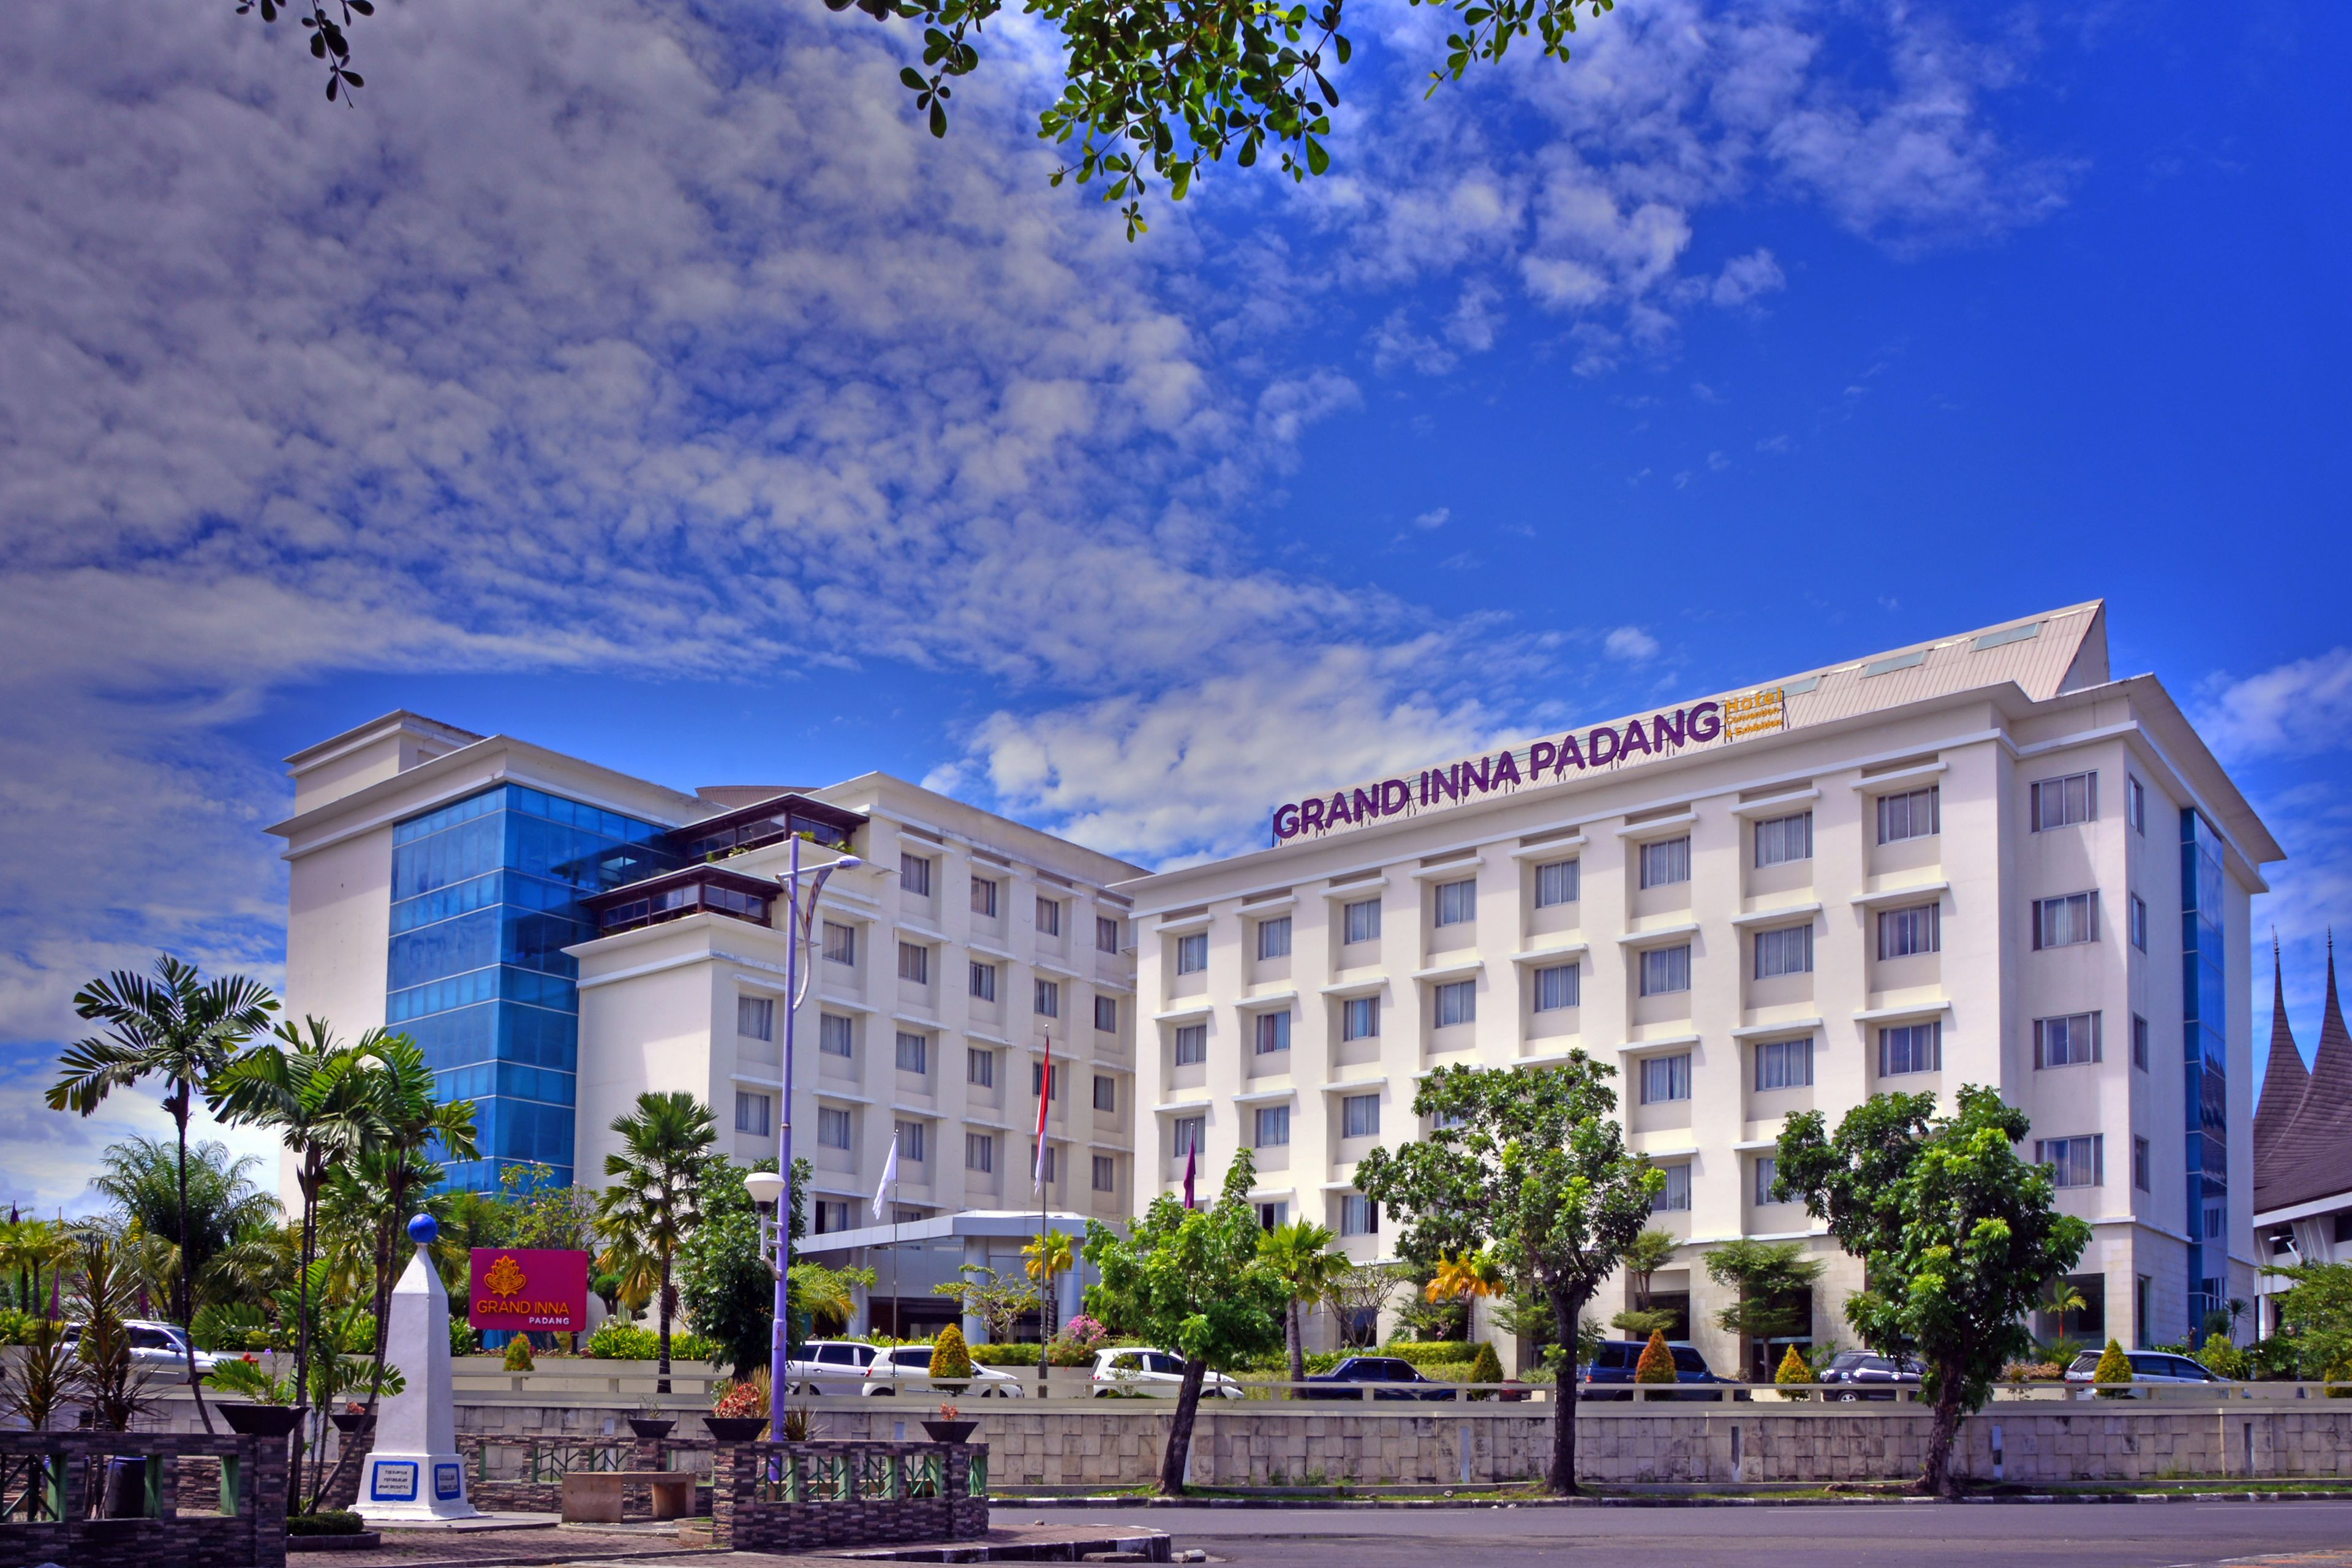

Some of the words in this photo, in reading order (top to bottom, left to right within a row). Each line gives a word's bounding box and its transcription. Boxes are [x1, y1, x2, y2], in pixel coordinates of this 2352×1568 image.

[1725, 686, 1782, 714] Hotel
[1725, 707, 1779, 725] Convention
[1735, 719, 1782, 736] Exhibition
[1274, 779, 1409, 839] GRAND
[1421, 751, 1521, 806] INNA
[1531, 702, 1720, 780] PADANG
[477, 1300, 530, 1314] GRAND
[535, 1302, 569, 1314] INNA
